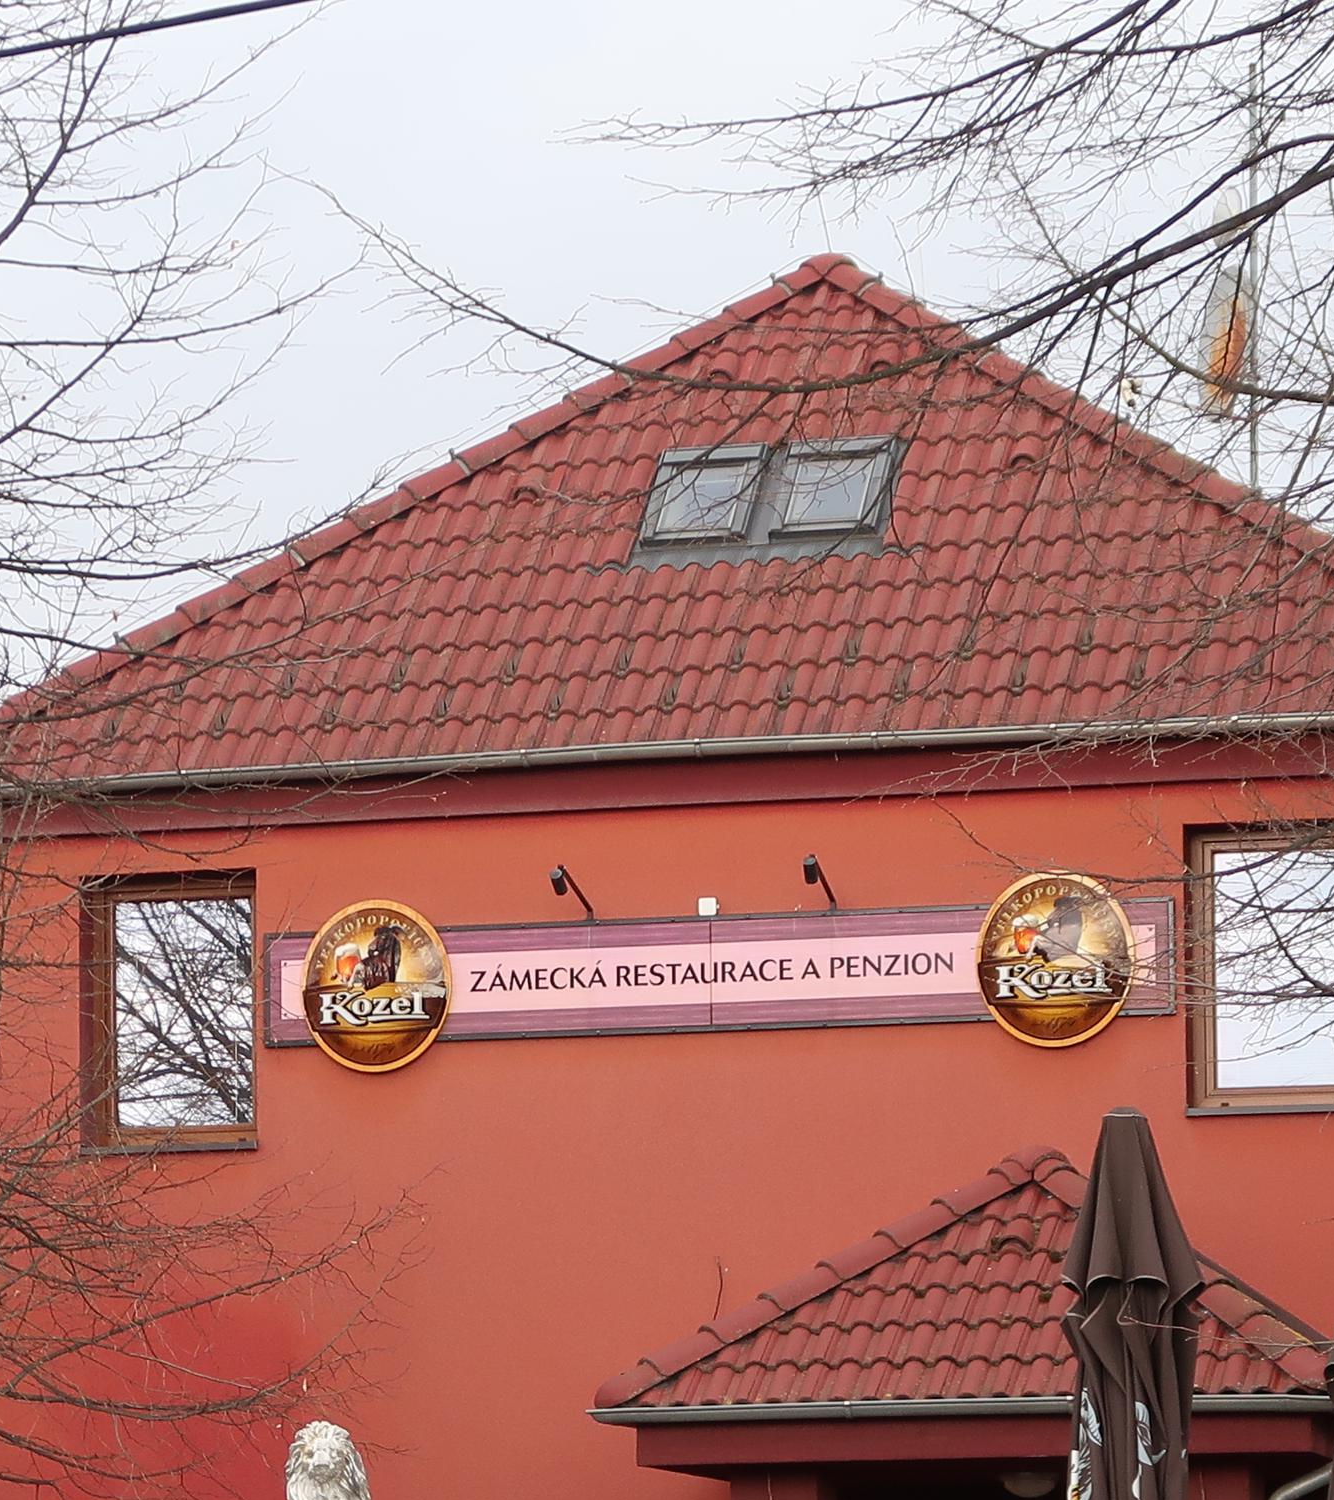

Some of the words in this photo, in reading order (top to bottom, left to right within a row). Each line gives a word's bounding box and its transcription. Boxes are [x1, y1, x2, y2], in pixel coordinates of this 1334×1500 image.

[470, 960, 607, 992] ZÁMECKÁ
[616, 959, 794, 987] RESTAURACE
[801, 958, 821, 979] A
[830, 952, 954, 979] PENZION
[996, 962, 1112, 999] Kozel
[319, 971, 430, 1026] Kozel
